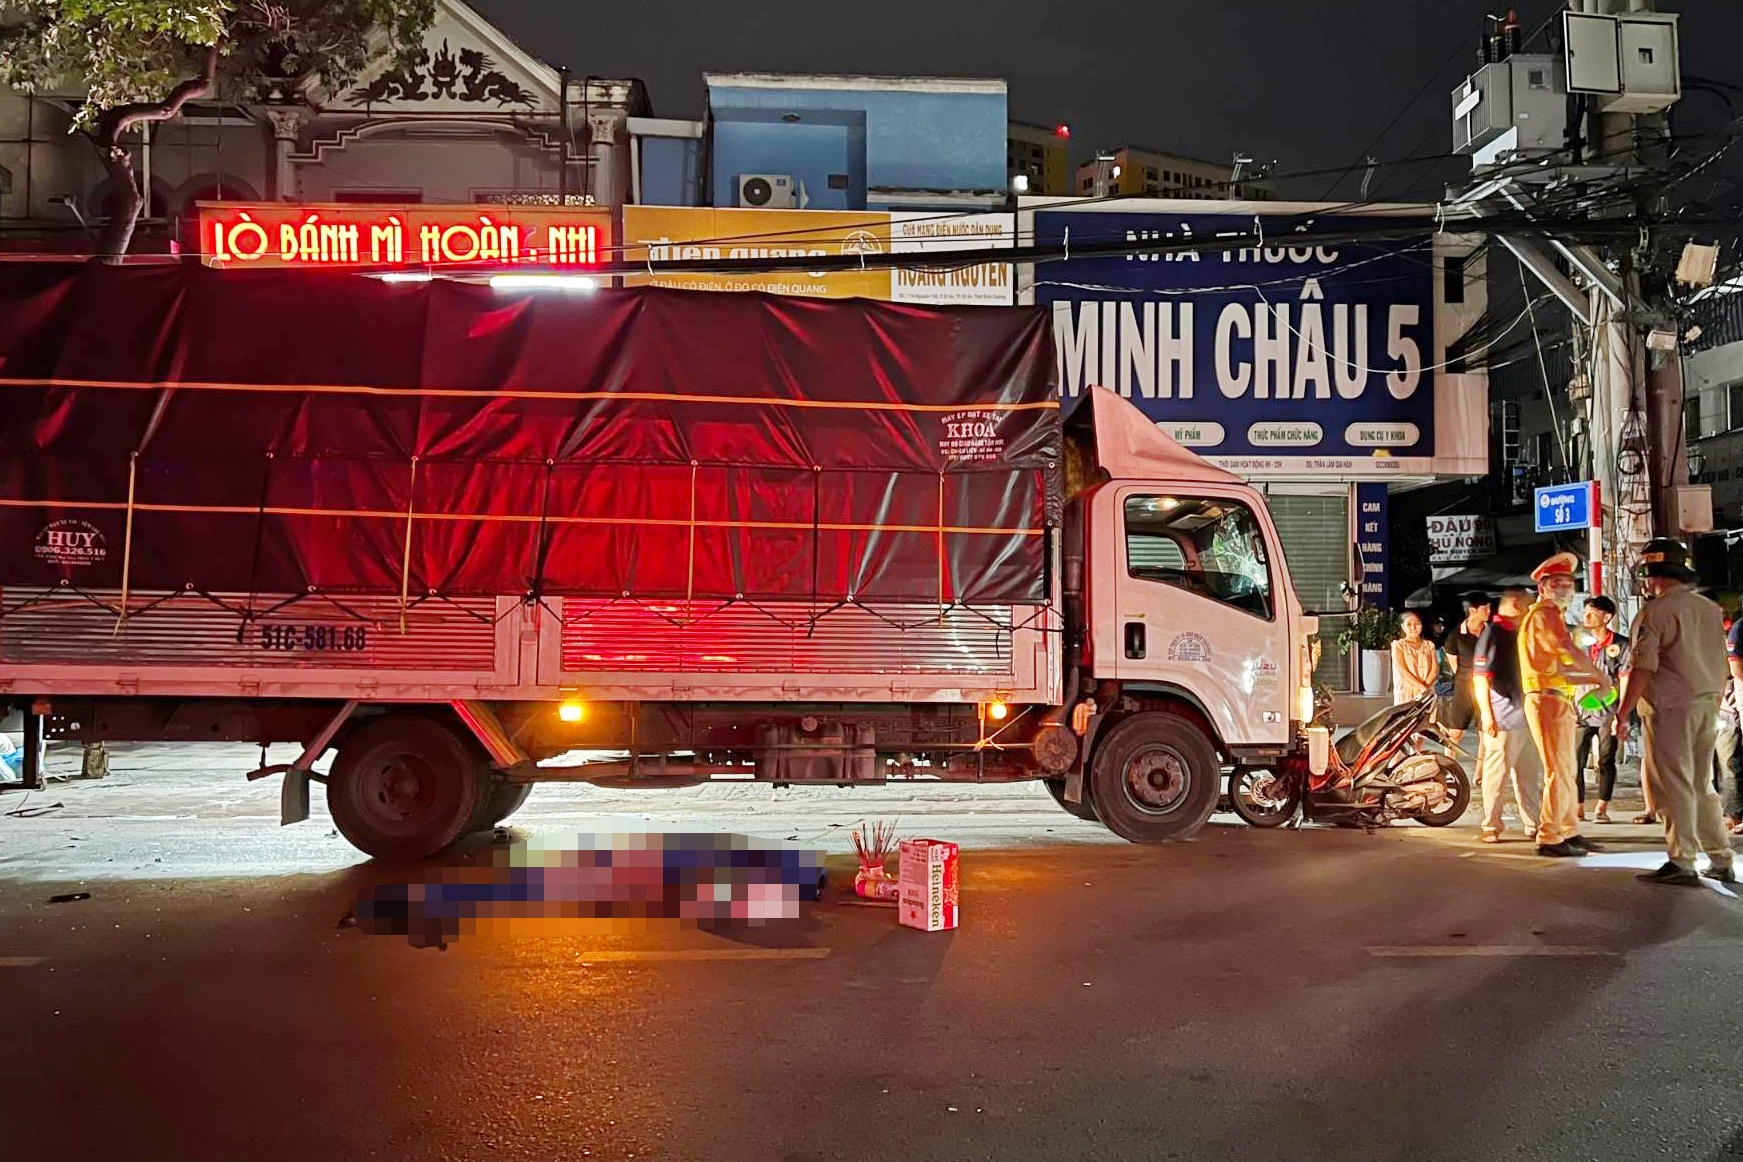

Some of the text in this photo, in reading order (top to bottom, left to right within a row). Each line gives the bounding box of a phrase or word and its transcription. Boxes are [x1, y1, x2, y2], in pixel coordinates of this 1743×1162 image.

[214, 213, 269, 262] LÒ
[279, 215, 359, 262] BÁNH
[371, 217, 402, 262] MÌ
[548, 226, 596, 263] NHI
[791, 284, 827, 294] QUANG
[1053, 278, 1421, 400] MINH CHÂU 5
[947, 422, 996, 438] KHOA
[1362, 503, 1380, 513] CAM
[1565, 507, 1570, 522] 3
[47, 531, 96, 548] HUY
[262, 624, 366, 650] 51C-581.68
[932, 864, 942, 927] Heineken
